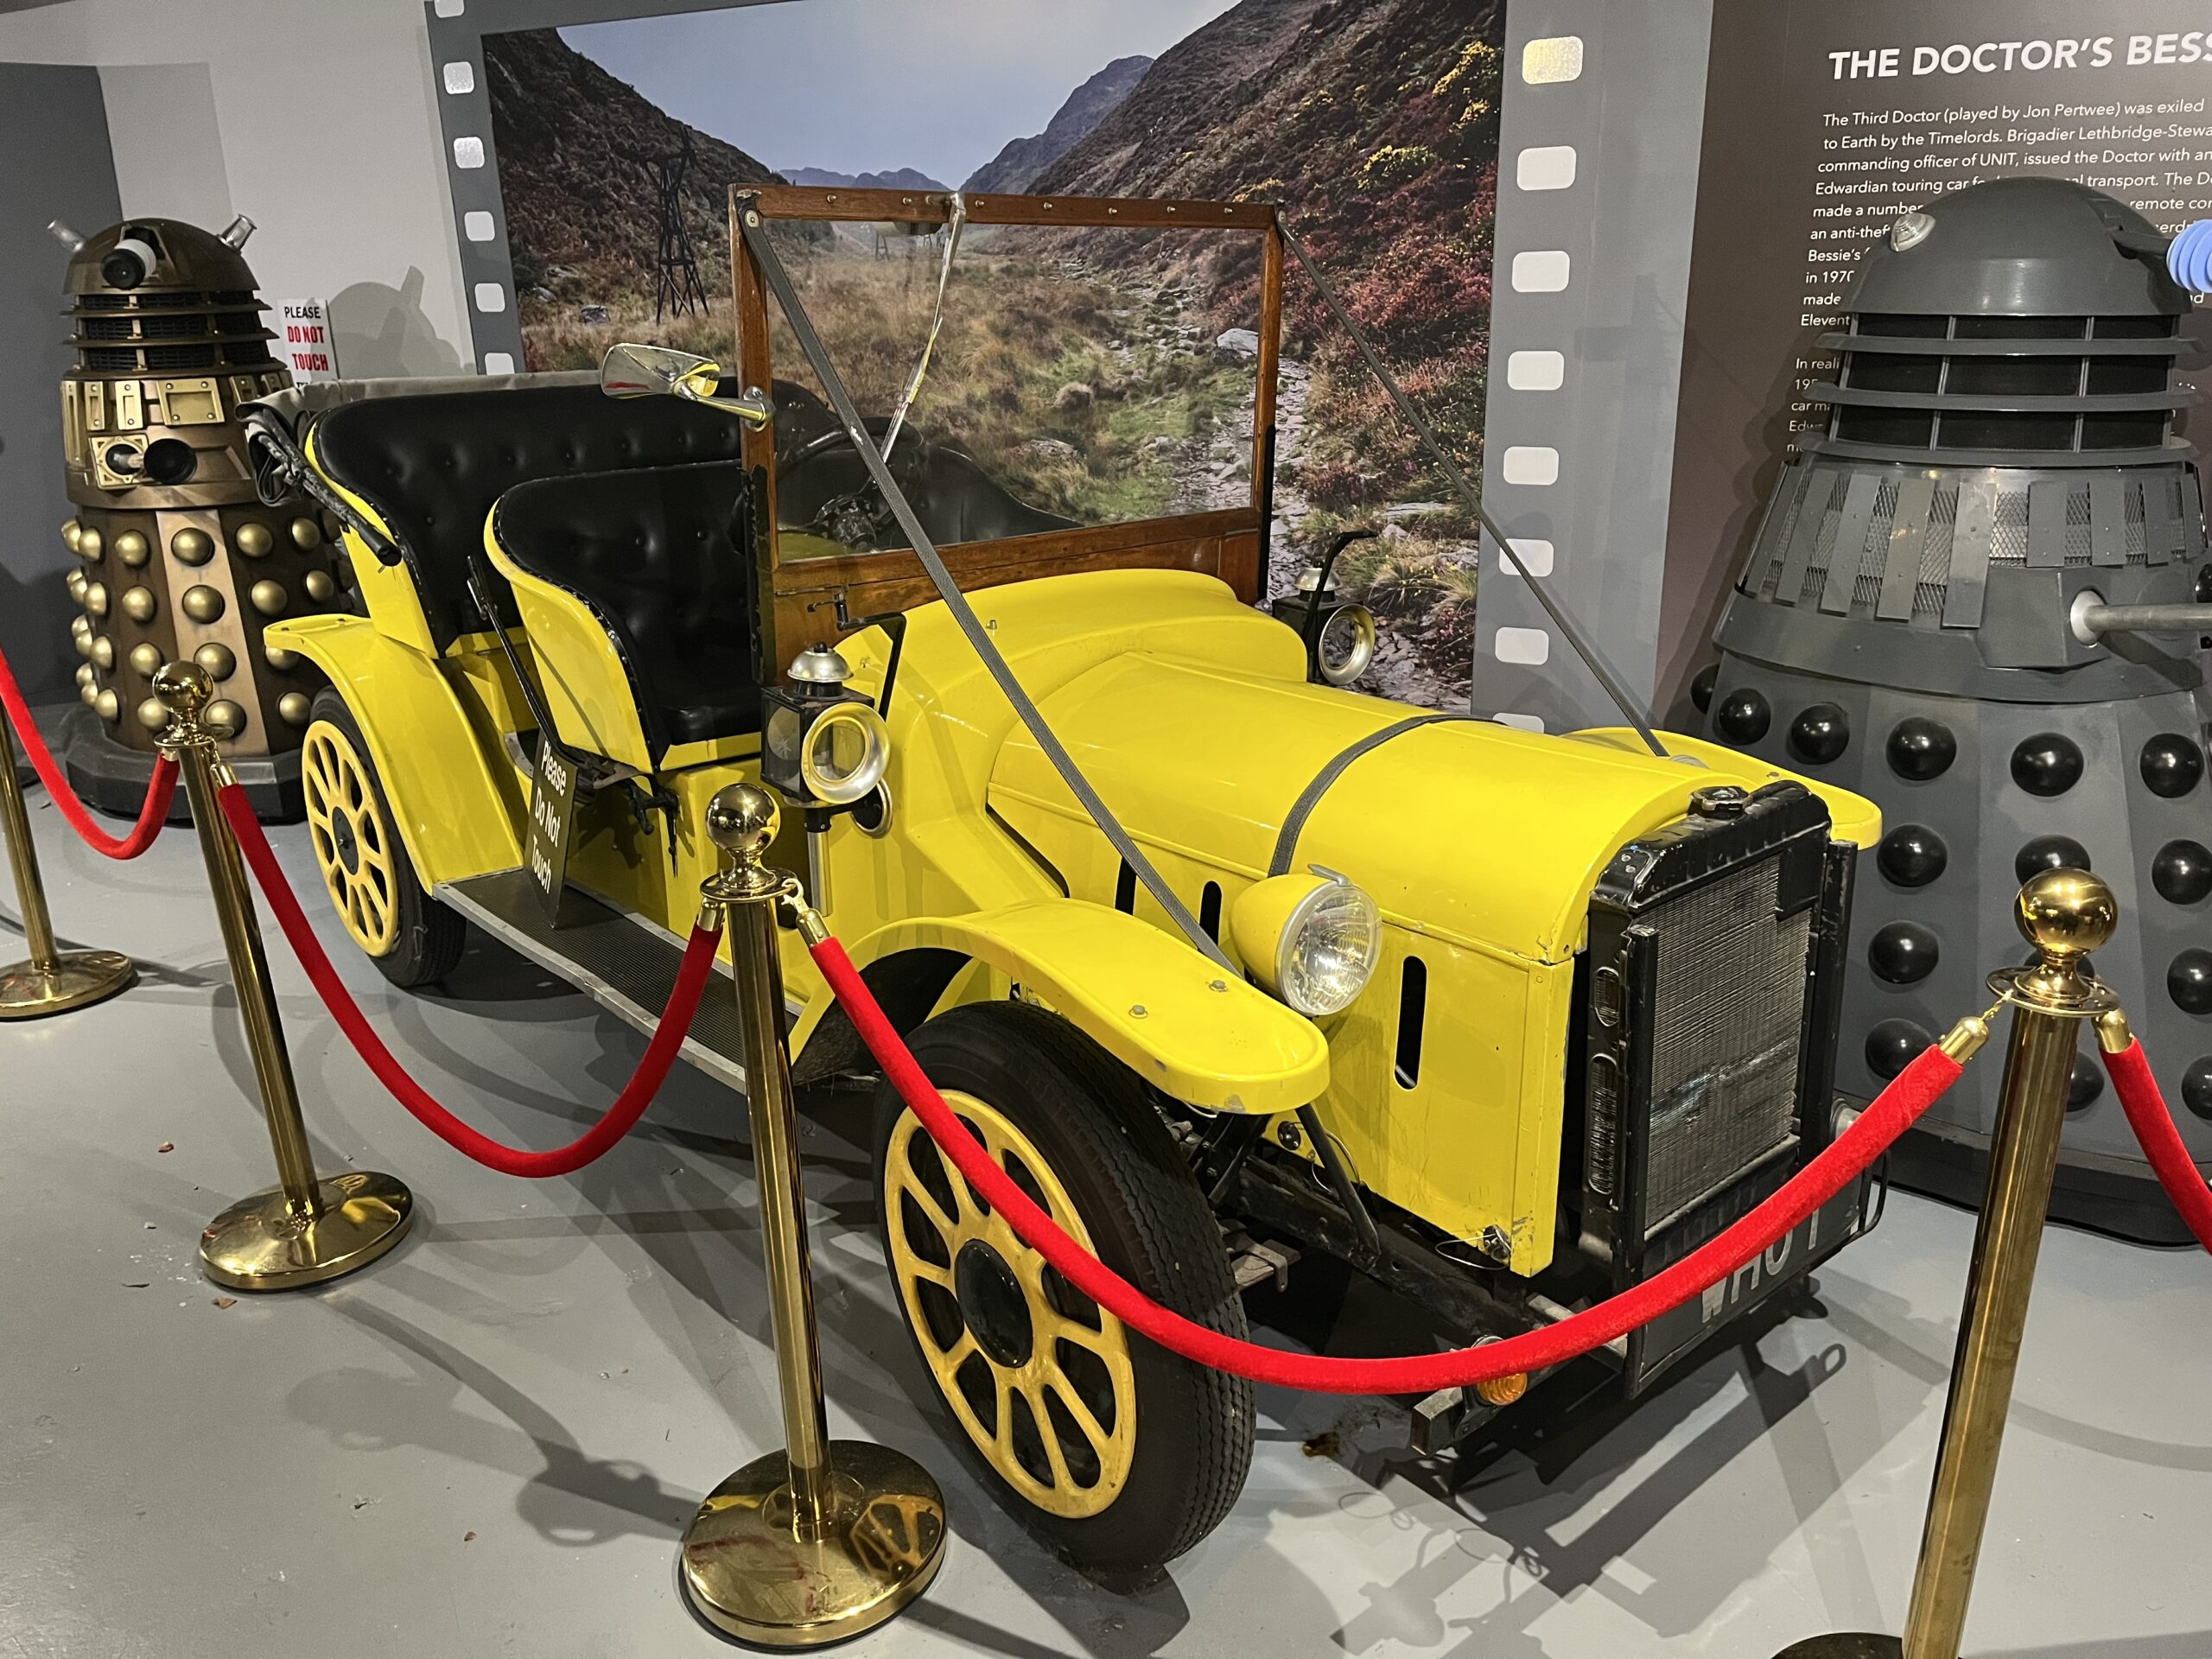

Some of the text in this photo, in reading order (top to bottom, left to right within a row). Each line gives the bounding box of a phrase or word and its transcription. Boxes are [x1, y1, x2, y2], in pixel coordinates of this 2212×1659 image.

[1828, 48, 1900, 79] THE
[1823, 99, 2204, 127] The Third Doctor (played by Jon Pertwee) was exiled
[1823, 138, 1838, 149] to
[1841, 135, 1877, 149] Earth
[1881, 134, 1898, 150] by
[1902, 133, 1924, 146] the
[1928, 130, 2003, 145] Timelords.
[2007, 128, 2075, 145] Brigadier
[1818, 156, 1910, 173] commanding
[1913, 154, 1959, 168] officer
[1961, 153, 1977, 167] of
[1980, 152, 2019, 167] UNIT,
[2024, 150, 2071, 165] issued
[2075, 149, 2098, 163] the
[2102, 149, 2154, 163] Doctor
[2159, 147, 2190, 162] with
[1815, 181, 1888, 195] Edwardian
[1891, 178, 1942, 194] touring
[1946, 180, 1969, 189] car
[2087, 175, 2158, 189] transport.
[2164, 172, 2193, 186] The
[1814, 204, 1852, 217] made
[1855, 207, 1864, 216] a
[2130, 198, 2185, 210] remote
[1810, 229, 1827, 239] an
[1805, 271, 1818, 283] in
[284, 306, 321, 319] PLEASE
[287, 326, 324, 344] DO NOT
[292, 353, 329, 372] TOUCH
[1796, 357, 1808, 370] In
[1791, 402, 1811, 411] car
[541, 740, 567, 797] Please
[534, 786, 561, 848] Do Not
[531, 834, 552, 894] Touch
